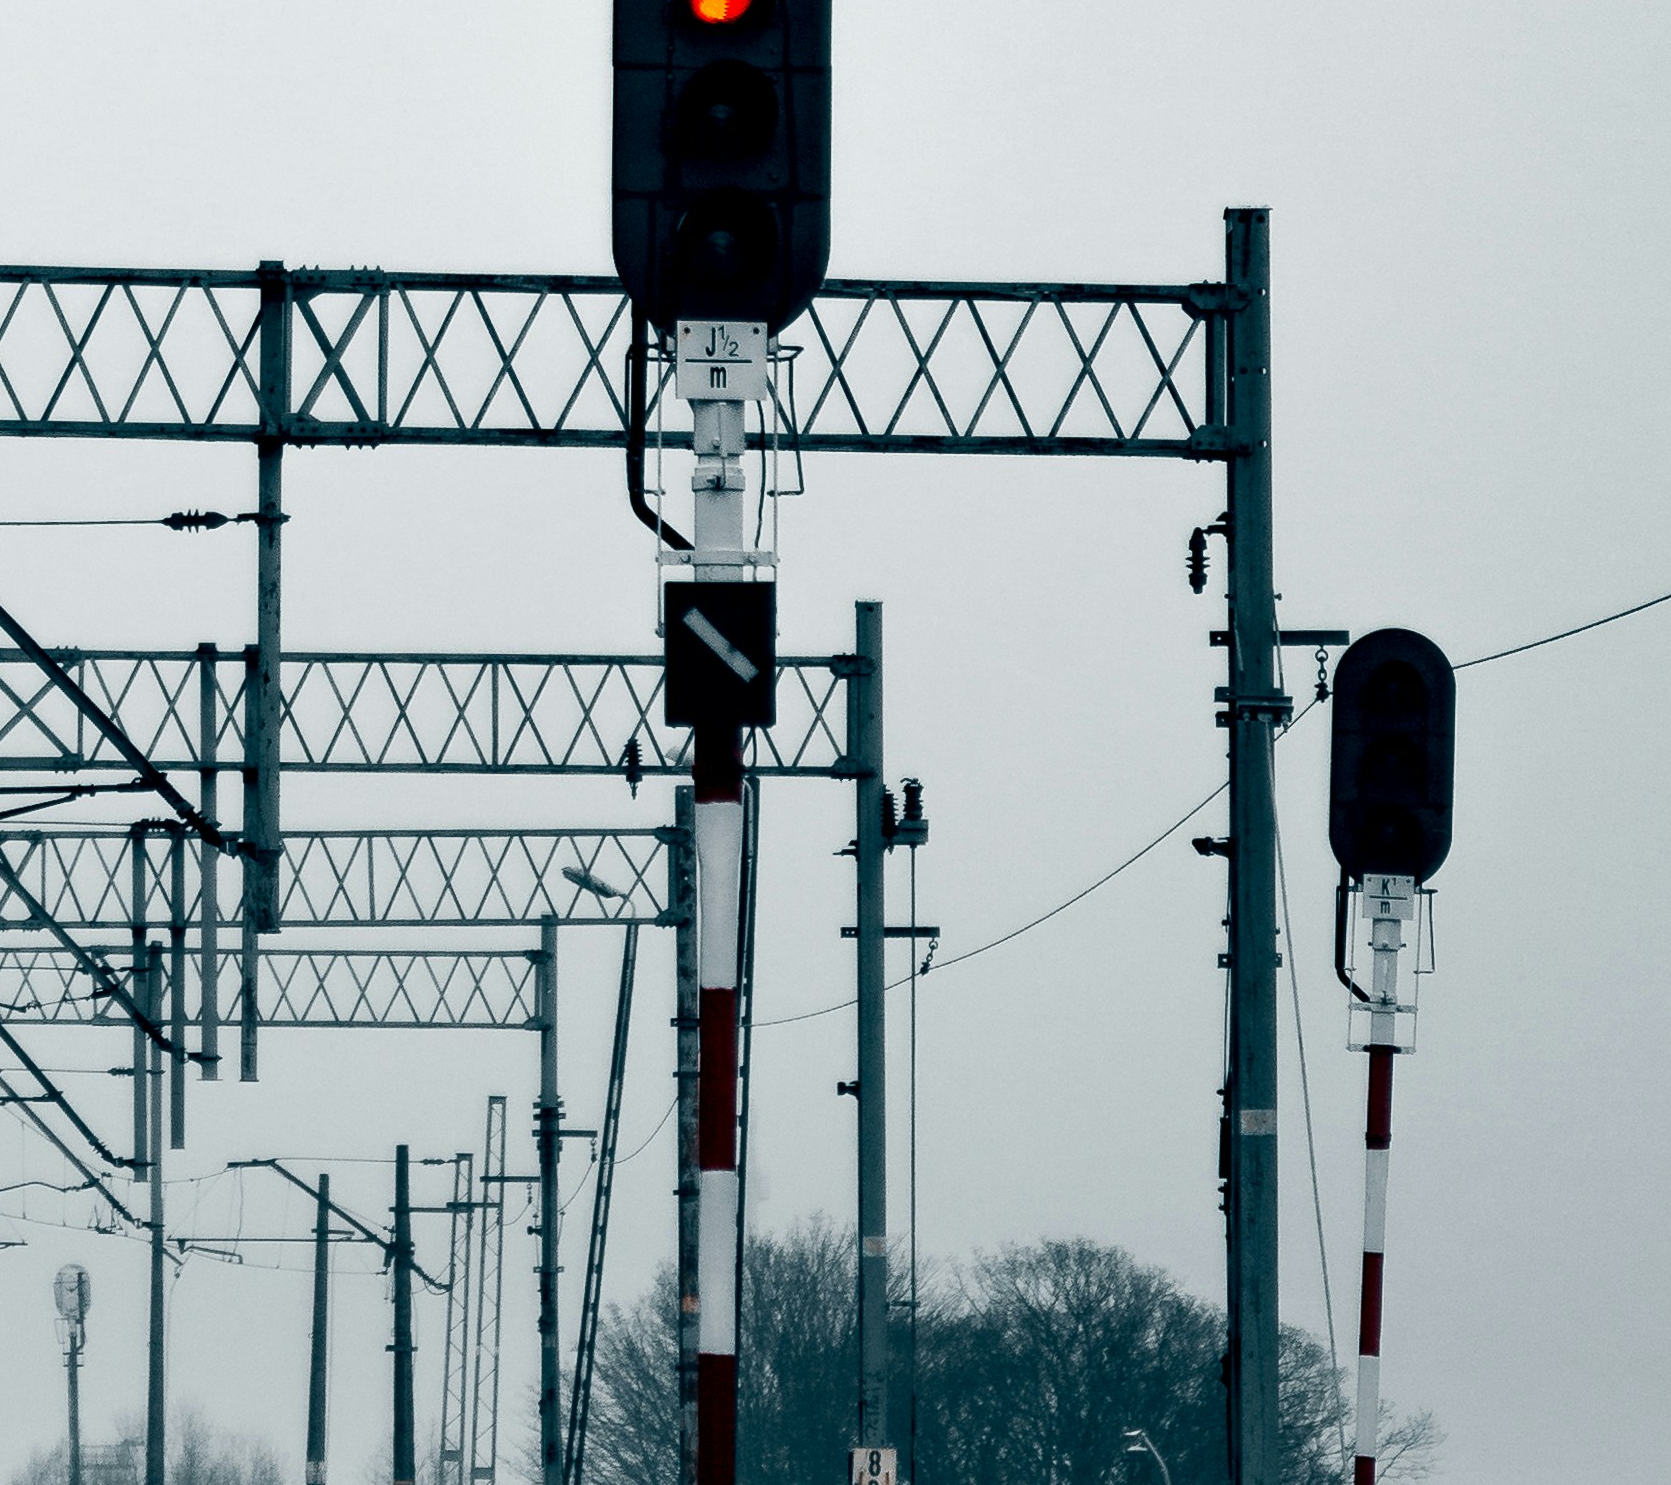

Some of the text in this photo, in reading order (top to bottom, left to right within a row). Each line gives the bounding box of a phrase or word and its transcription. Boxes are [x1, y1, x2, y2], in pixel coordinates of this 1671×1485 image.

[710, 366, 727, 389] m
[1380, 900, 1391, 914] m
[868, 1450, 881, 1477] 8
